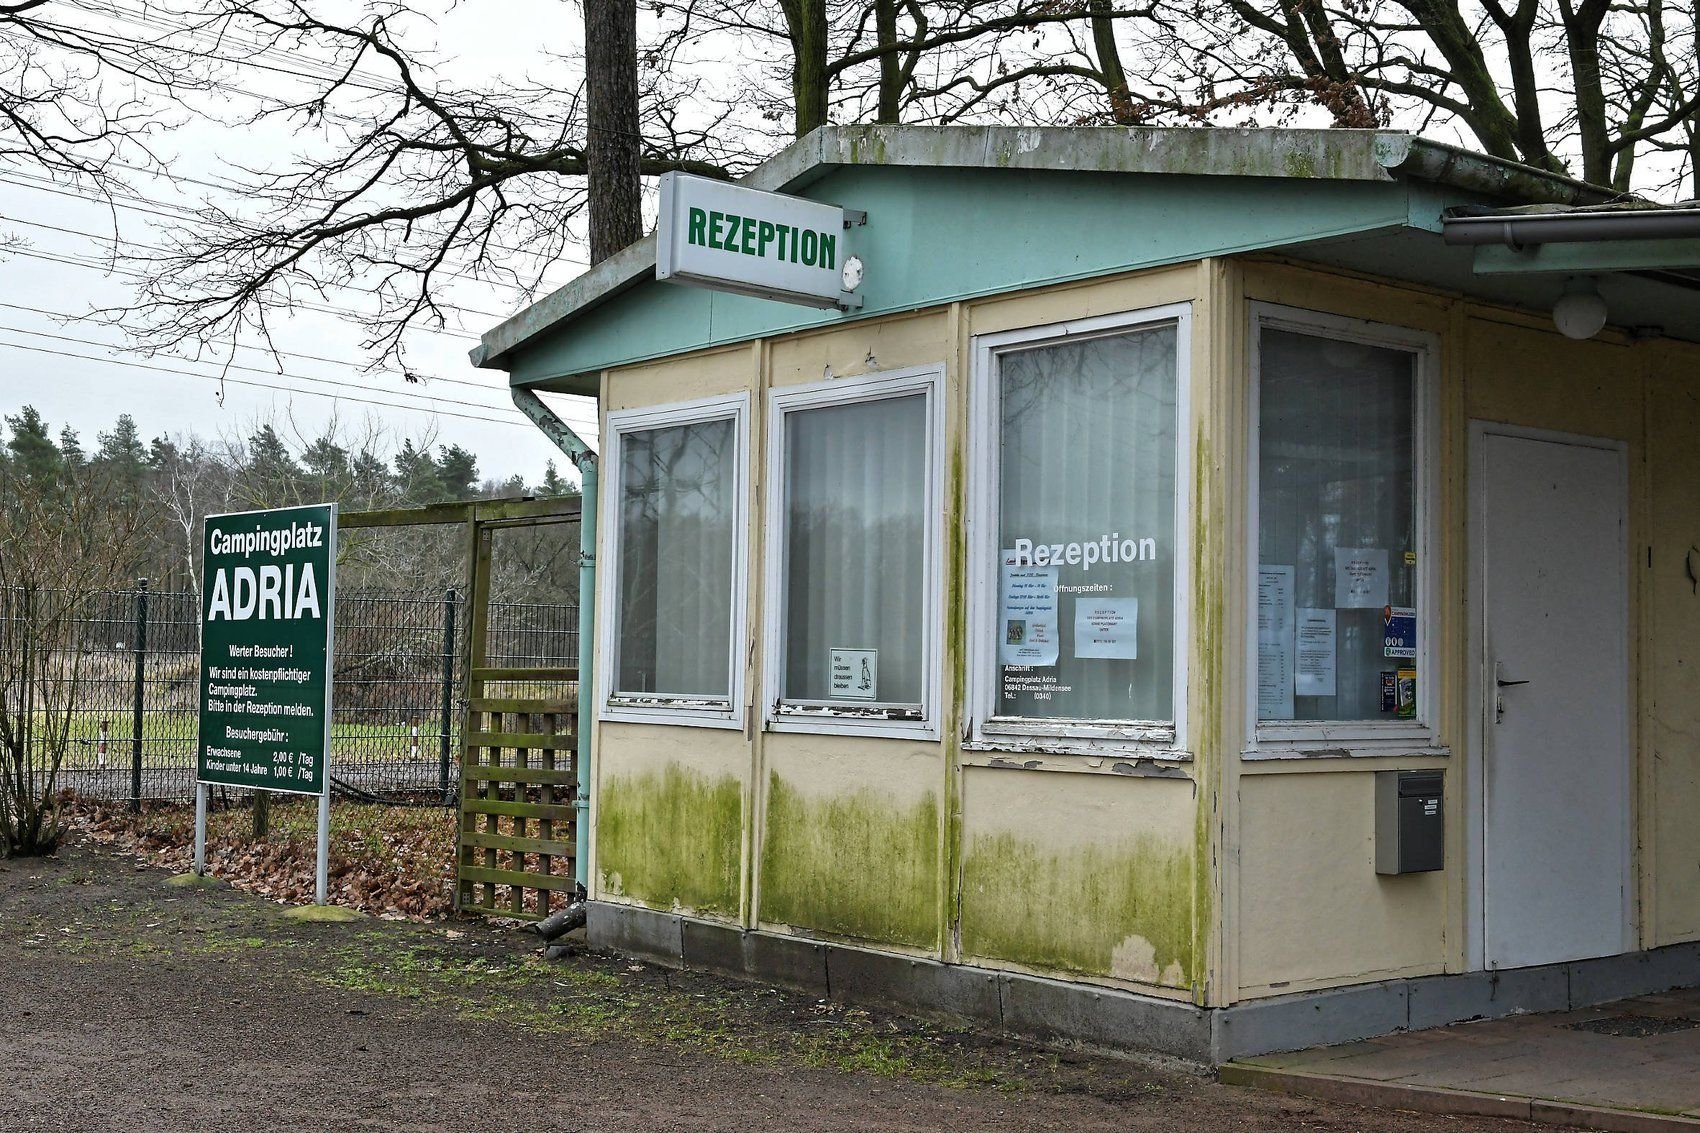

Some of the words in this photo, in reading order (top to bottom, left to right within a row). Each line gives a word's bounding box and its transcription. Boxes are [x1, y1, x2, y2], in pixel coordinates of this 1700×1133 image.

[688, 206, 836, 270] REZEPTION
[210, 522, 322, 558] Campingplatz
[1015, 532, 1156, 570] Rezeption
[208, 562, 320, 621] ADRIA
[229, 644, 253, 657] Werter
[254, 644, 289, 658] Besucher
[1392, 648, 1415, 657] APPROVED
[208, 666, 221, 679] Wir
[222, 667, 237, 679] sind
[238, 667, 249, 679] ein
[250, 667, 311, 684] kostenpflichtiger
[1004, 675, 1041, 684] Campingplatz
[208, 682, 257, 698] Campingplatz.
[208, 700, 224, 712] Bitte
[225, 700, 232, 712] in
[233, 701, 246, 713] der
[247, 701, 282, 716] Rezeption
[284, 703, 314, 716] melden.
[226, 725, 284, 743] Besuchergebühr
[206, 745, 241, 758] Erwachsene
[273, 752, 286, 764] 2,00
[288, 752, 293, 763] €
[298, 752, 314, 767] /Tag
[206, 759, 225, 771] Kinder
[226, 762, 241, 772] unter
[243, 763, 249, 773] 14
[250, 763, 267, 775] Jahre
[274, 766, 286, 778] 1,00
[288, 767, 293, 777] €
[298, 766, 313, 782] /Tag
